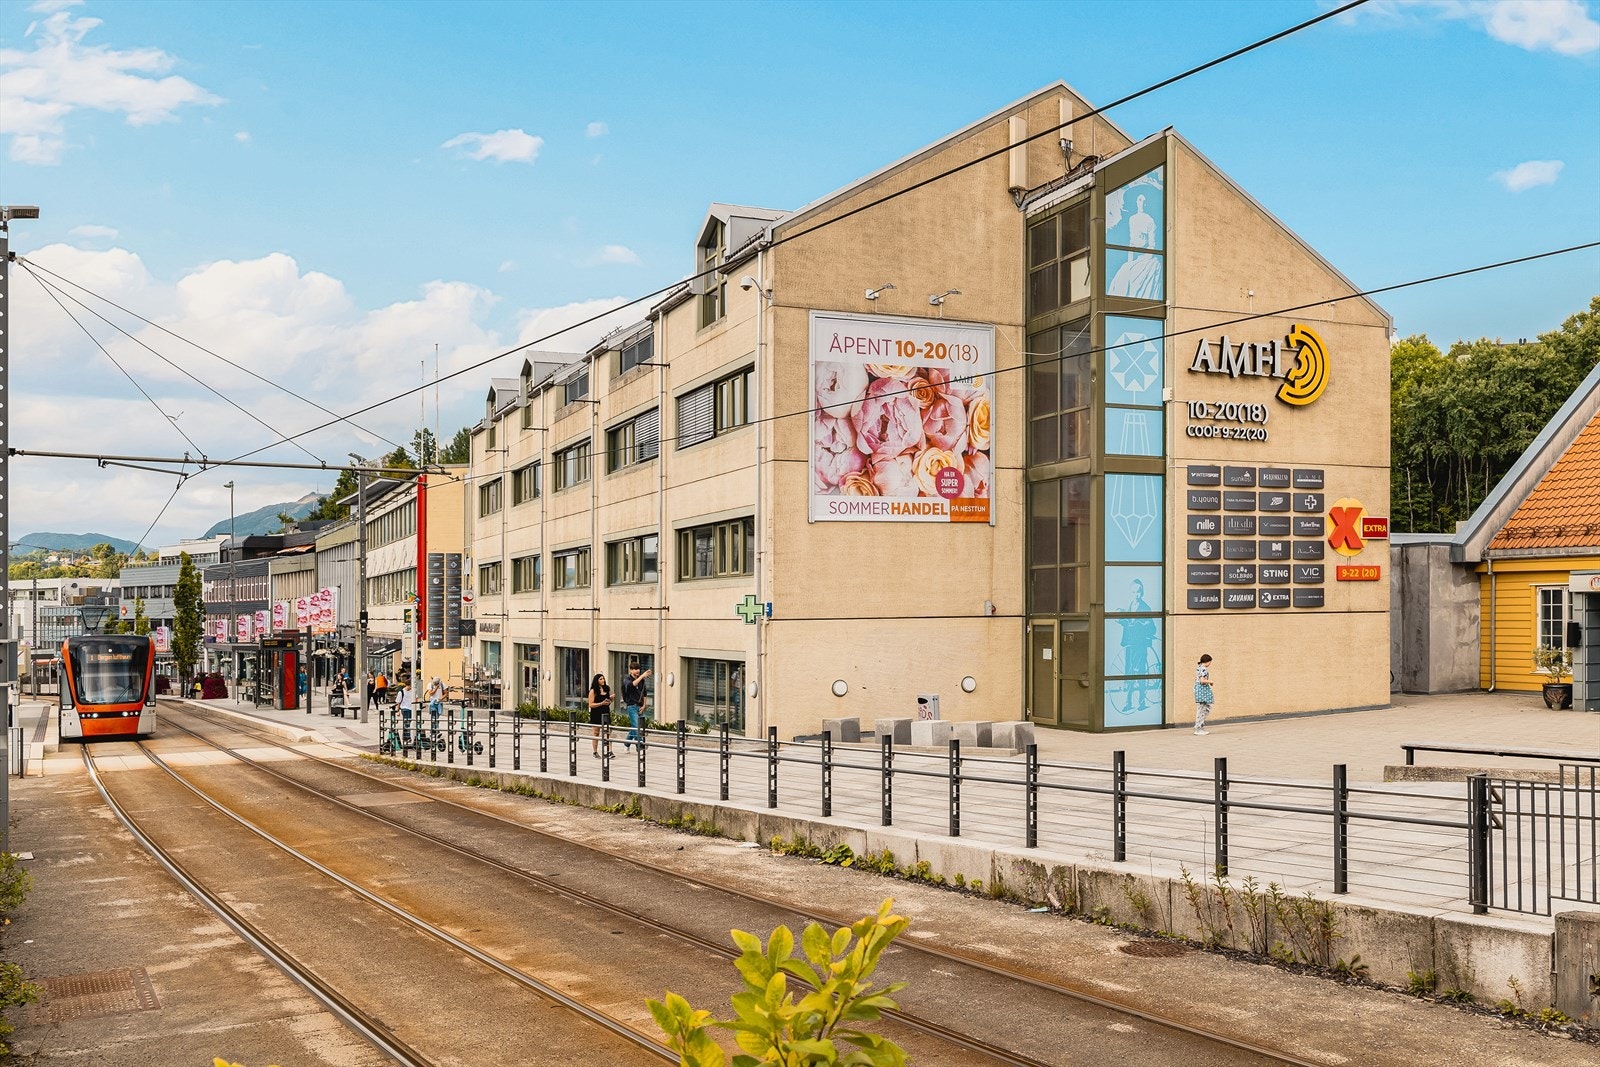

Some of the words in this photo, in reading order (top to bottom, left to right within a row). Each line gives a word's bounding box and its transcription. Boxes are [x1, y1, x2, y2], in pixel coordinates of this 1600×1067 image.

[829, 332, 892, 357] ÅPENT
[1190, 335, 1286, 378] AMFI
[1188, 400, 1269, 425] 10-20(18)
[1187, 424, 1219, 437] COOP
[1222, 427, 1269, 442] 9-22(20)
[940, 478, 959, 487] SUPER
[951, 504, 959, 512] PÅ
[960, 505, 986, 513] NESTTUN
[1196, 518, 1215, 530] nille
[1364, 524, 1387, 532] EXTRA
[1263, 569, 1289, 578] STING
[1301, 567, 1320, 576] VIC
[1342, 568, 1359, 578] 9-22
[1361, 567, 1377, 578] (20)
